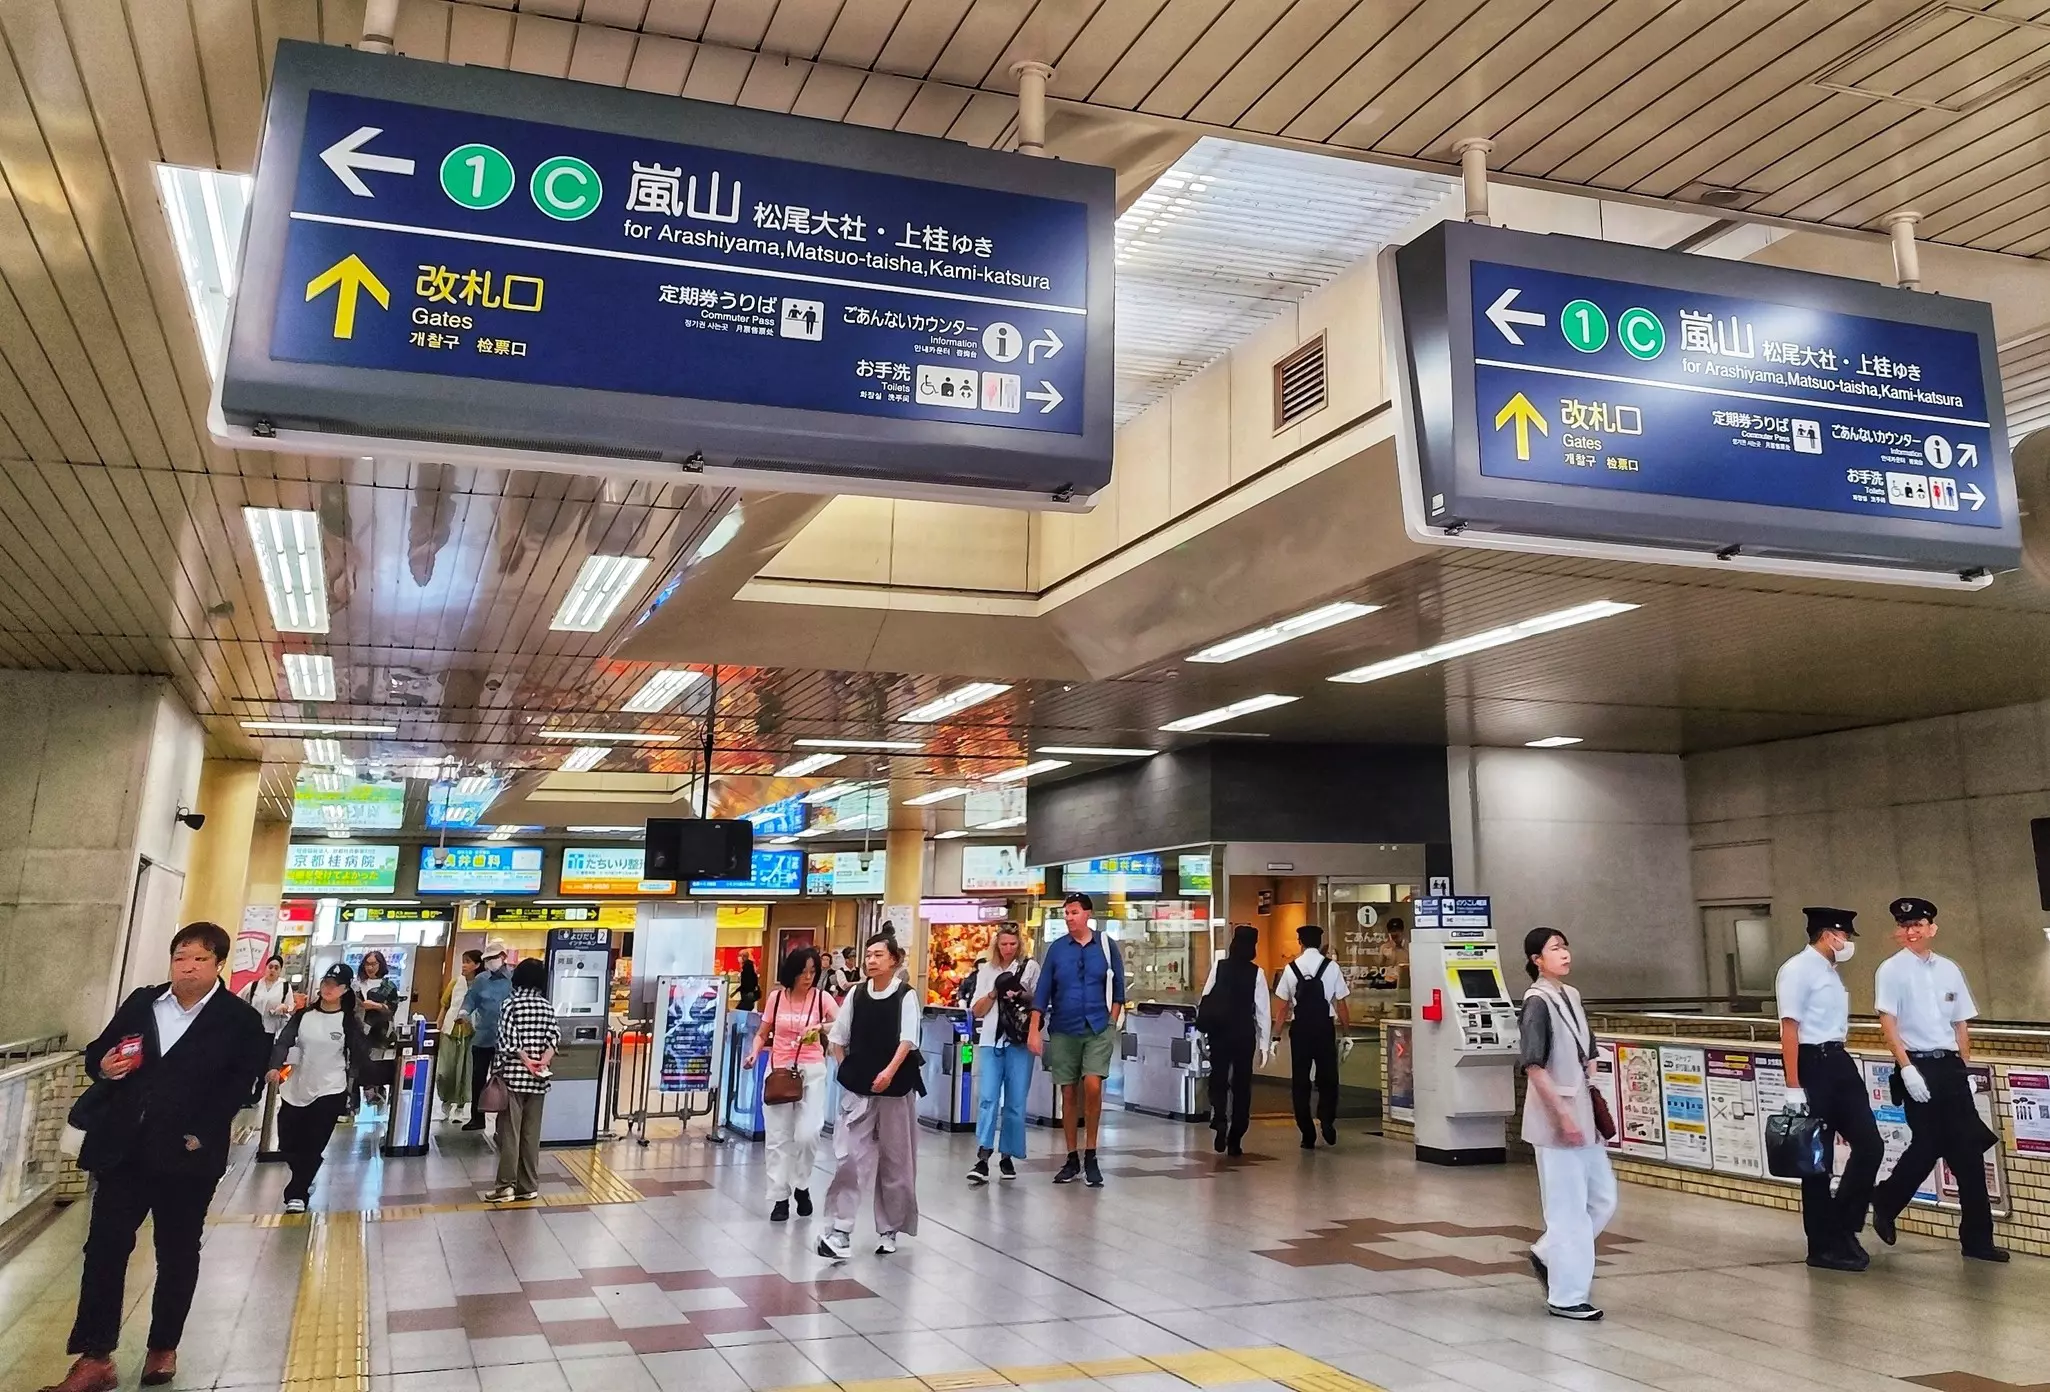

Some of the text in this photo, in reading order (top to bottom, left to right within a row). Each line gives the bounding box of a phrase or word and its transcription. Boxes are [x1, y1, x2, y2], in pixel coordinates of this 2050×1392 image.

[465, 155, 993, 258] 1 C 嵐山 松尾大社・上桂ゆき
[624, 219, 1051, 290] for Arashiyama,Matsuo-taisha,Kami-katsura
[416, 265, 544, 312] 改札口
[658, 284, 778, 314] 定期券うりば
[412, 307, 473, 329] Gates
[701, 309, 775, 326] Commuter Pass
[843, 306, 979, 336] ごあんないカウンター
[409, 332, 460, 350] 개찰구
[476, 337, 527, 356] 检票口
[930, 335, 978, 348] Information
[1575, 308, 1922, 382] 1 C 嵐山 松尾大社・上桂ゆき
[856, 359, 911, 382] お手洗
[881, 381, 910, 393] Toilets
[1682, 357, 1964, 408] for Arashiyama,Matsuo-taisha,Kami-katsura
[1560, 399, 1643, 435] 改札口
[1712, 410, 1790, 433] 定期券うりば
[1562, 433, 1603, 450] Gates
[1831, 423, 1922, 447] ごあんないカウンター
[1564, 453, 1597, 467] 개찰구
[1890, 447, 1923, 458] Information
[1606, 456, 1639, 471] 检票口
[1846, 468, 1885, 486] お手洗
[1865, 486, 1886, 496] Toilets
[293, 854, 376, 867] 京都桂病院
[570, 931, 605, 941] よびだし 2
